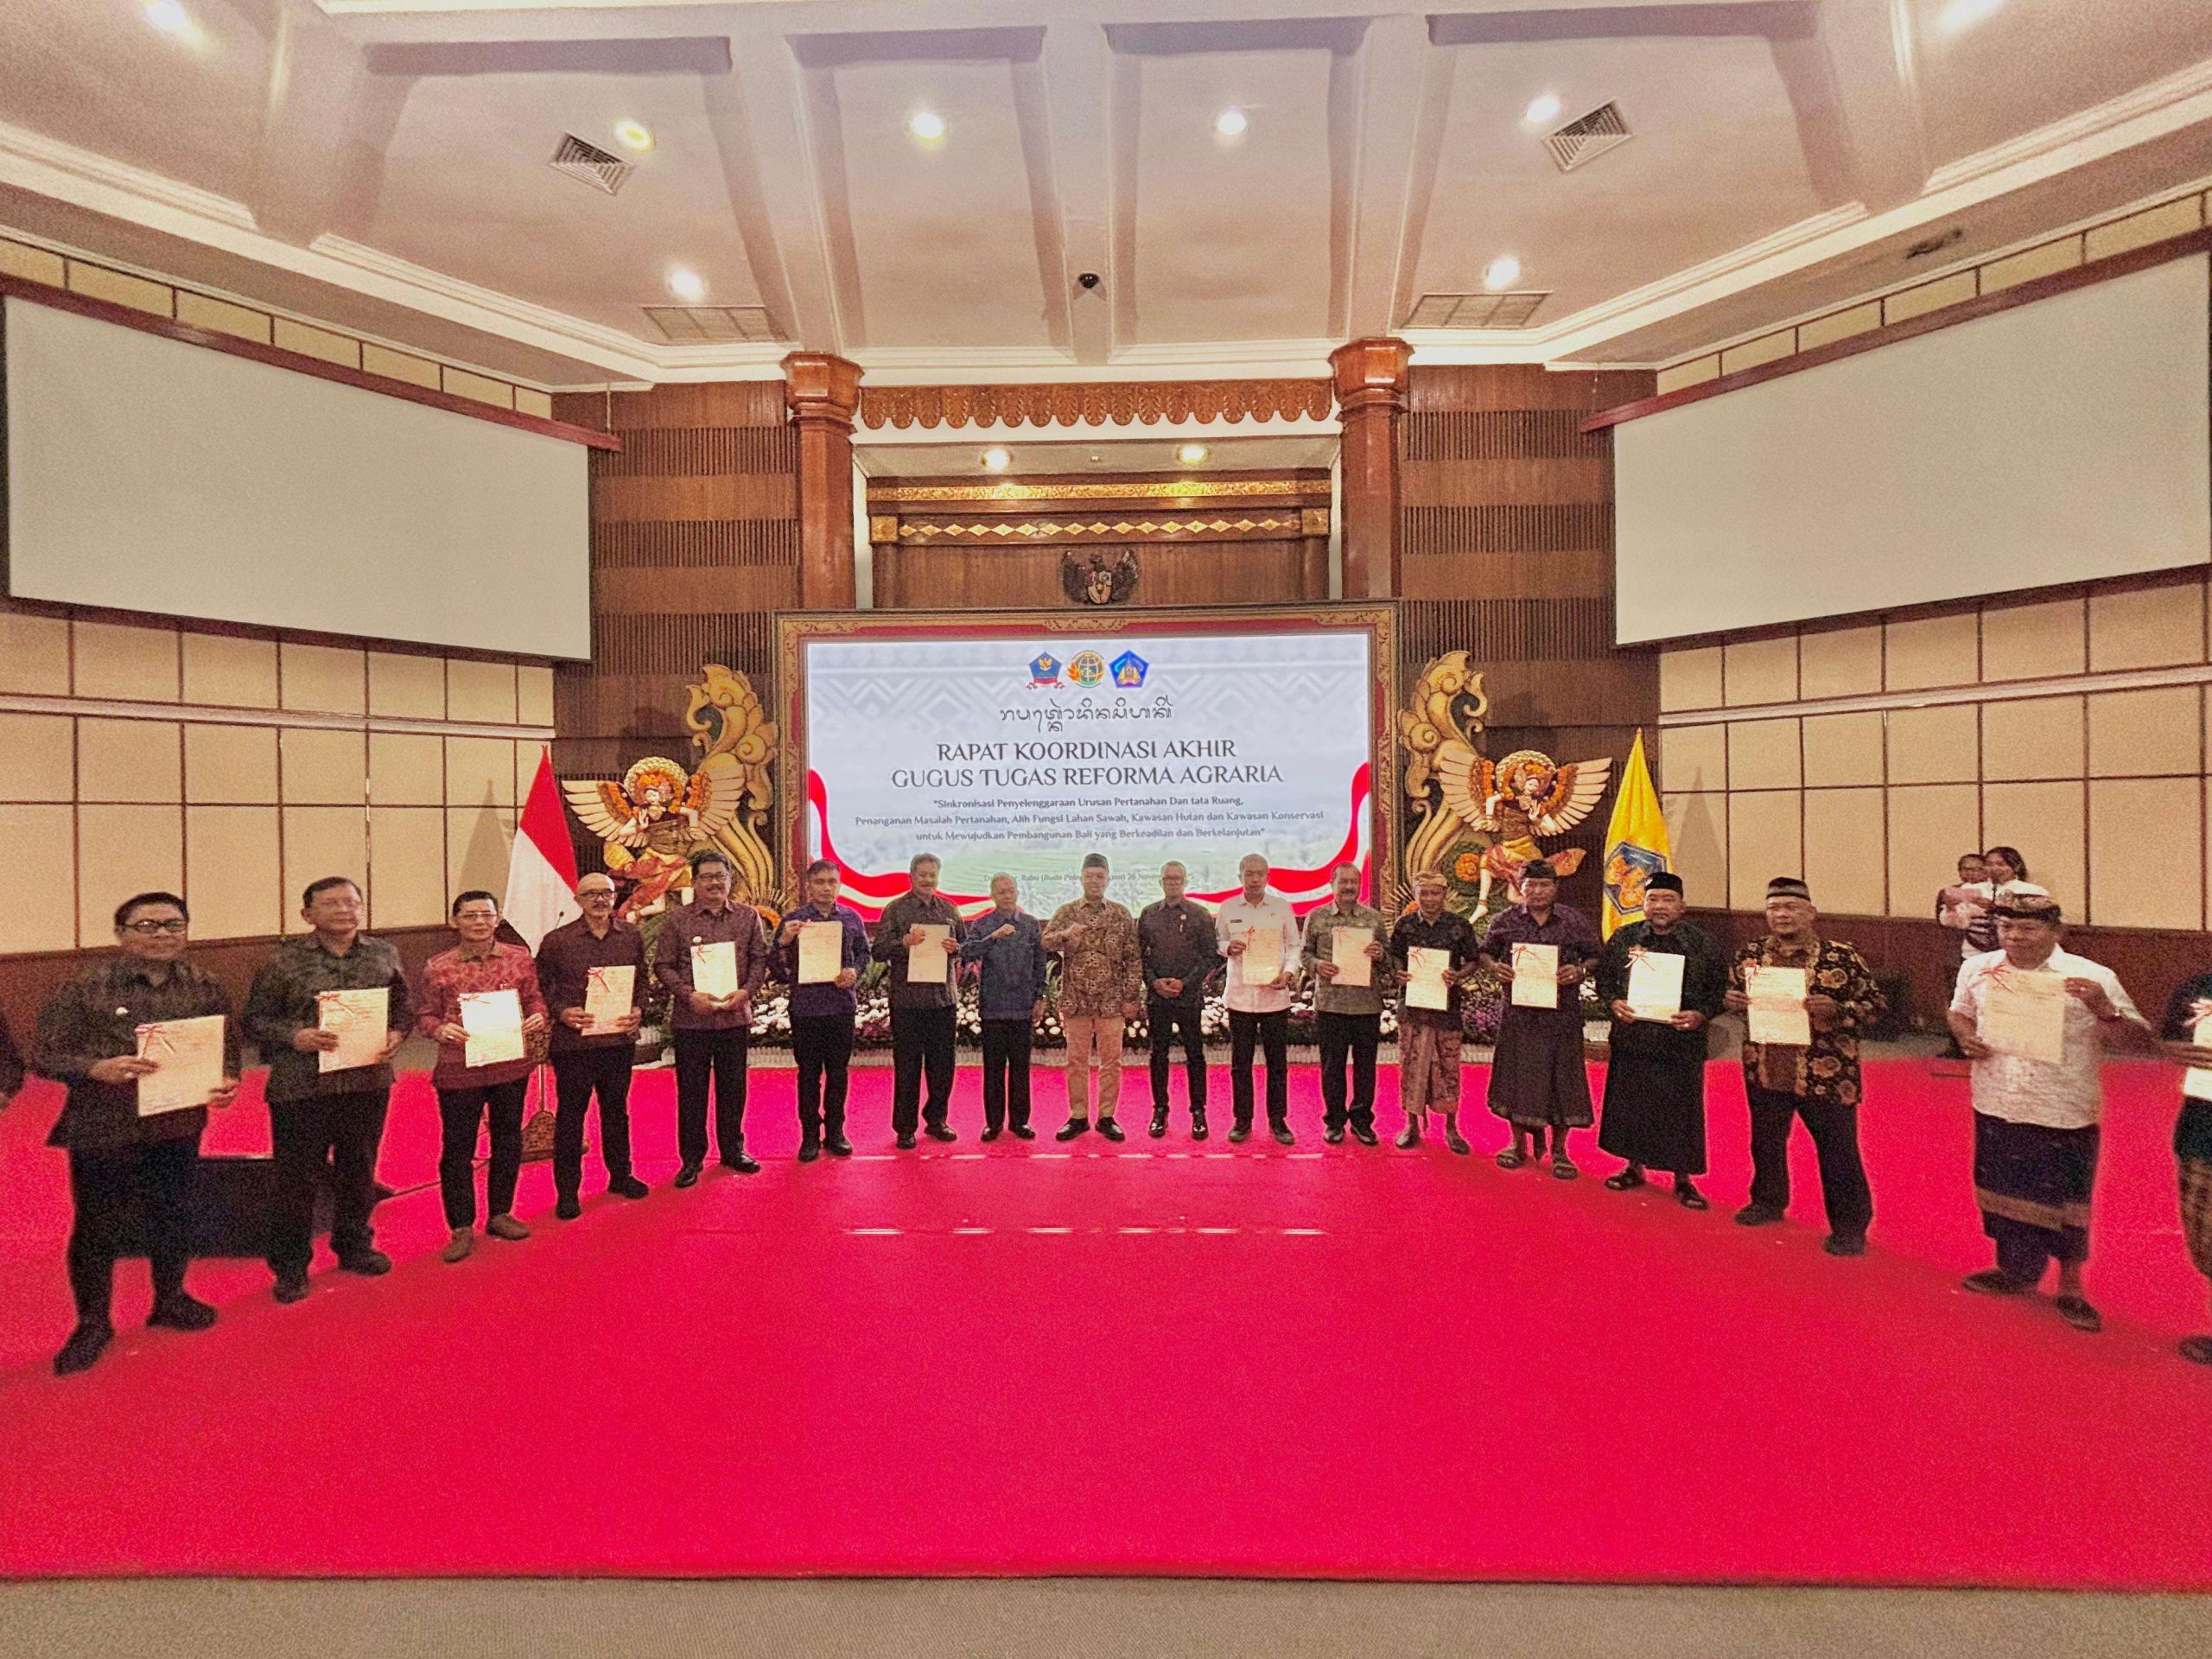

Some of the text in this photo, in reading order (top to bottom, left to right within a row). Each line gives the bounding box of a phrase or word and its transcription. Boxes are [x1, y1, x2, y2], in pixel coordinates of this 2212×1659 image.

[937, 740, 1237, 761] RAPAT KOORDINASI AKHIR
[891, 765, 1284, 788] GUGUS TUGAS REFORMA AGRARIA
[996, 798, 1076, 810] Penyelenggaraan
[1077, 798, 1112, 807] Urusan
[1114, 797, 1166, 807] Pertanahan
[1169, 796, 1189, 806] Dan
[1191, 796, 1210, 805] tata
[1211, 796, 1244, 808] Ruang,
[855, 810, 1324, 827] Penanganan Masalah Pertanahan, Alih Fungsi Lahan Sawah, Kawasan Hutan dan Kawasan Konservasi
[916, 831, 944, 841] untuk
[944, 830, 1005, 842] Mewujudkan
[1007, 830, 1072, 841] Pembangunan
[1075, 829, 1093, 838] Bali
[1094, 830, 1117, 841] yang
[1119, 828, 1174, 838] Berkeadilan
[1175, 828, 1193, 837] dan
